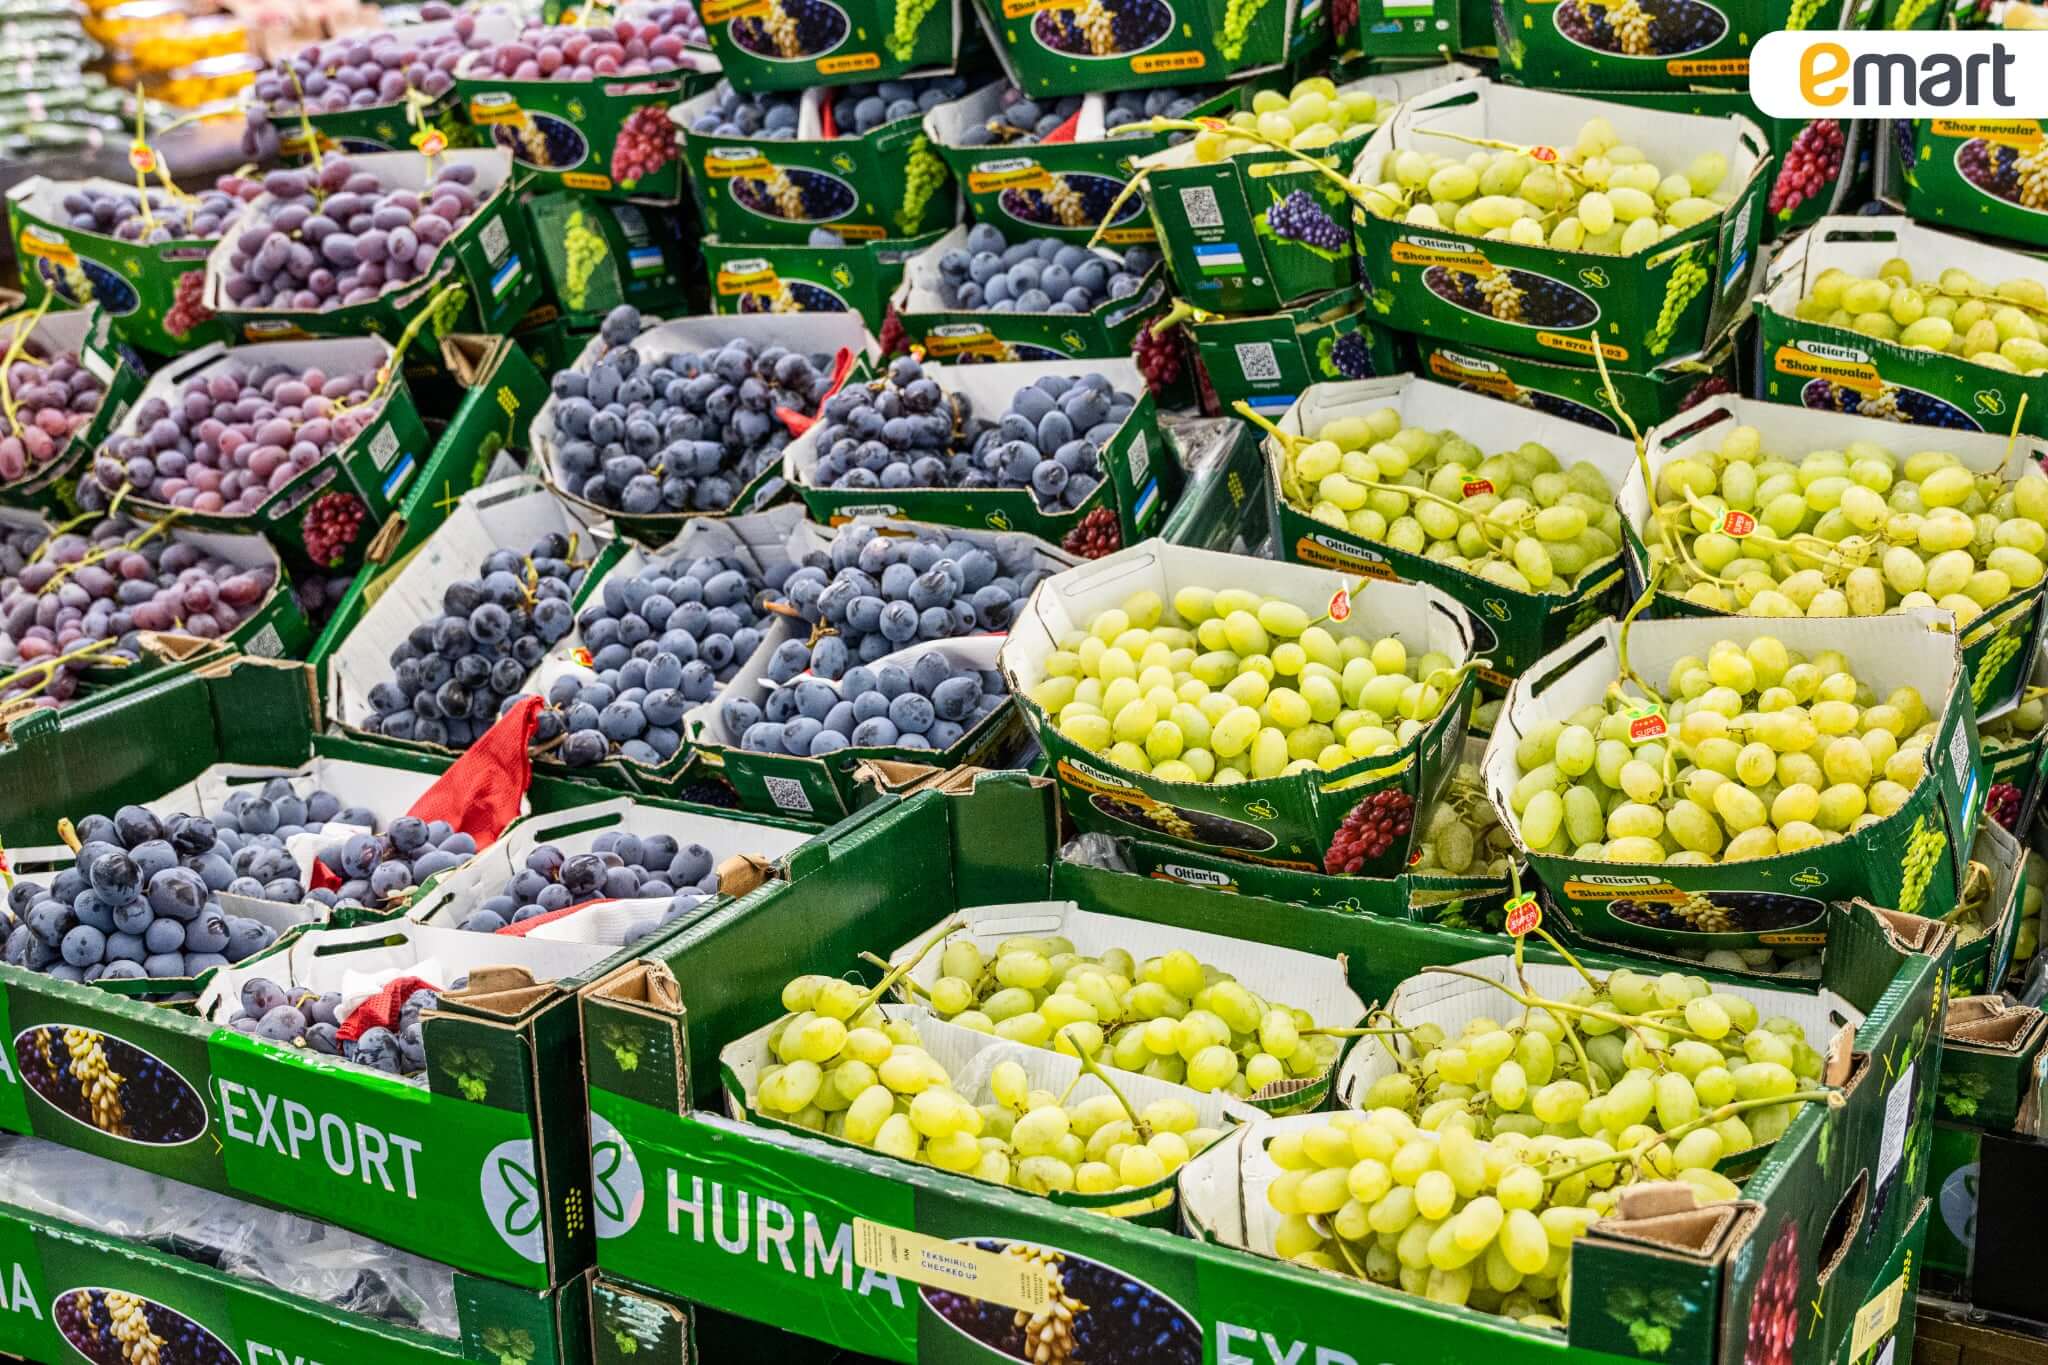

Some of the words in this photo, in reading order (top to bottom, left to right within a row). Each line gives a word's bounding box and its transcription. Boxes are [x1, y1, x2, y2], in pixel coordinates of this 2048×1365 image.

[1979, 124, 2036, 136] mevalar
[1807, 343, 1858, 363] Oltiariq
[1820, 365, 1874, 380] mevalar
[1325, 539, 1374, 561] Oltiariq
[1635, 725, 1663, 737] SUPER
[1174, 867, 1221, 885] Oltiariq
[1592, 875, 1651, 886] Oltiariq
[1615, 888, 1675, 896] mevalar
[218, 1078, 422, 1200] EXPORT
[667, 1168, 905, 1309] HURMA
[921, 1250, 977, 1271] TEKSHIRILDI
[921, 1260, 963, 1278] CHECKED
[965, 1272, 978, 1281] UP
